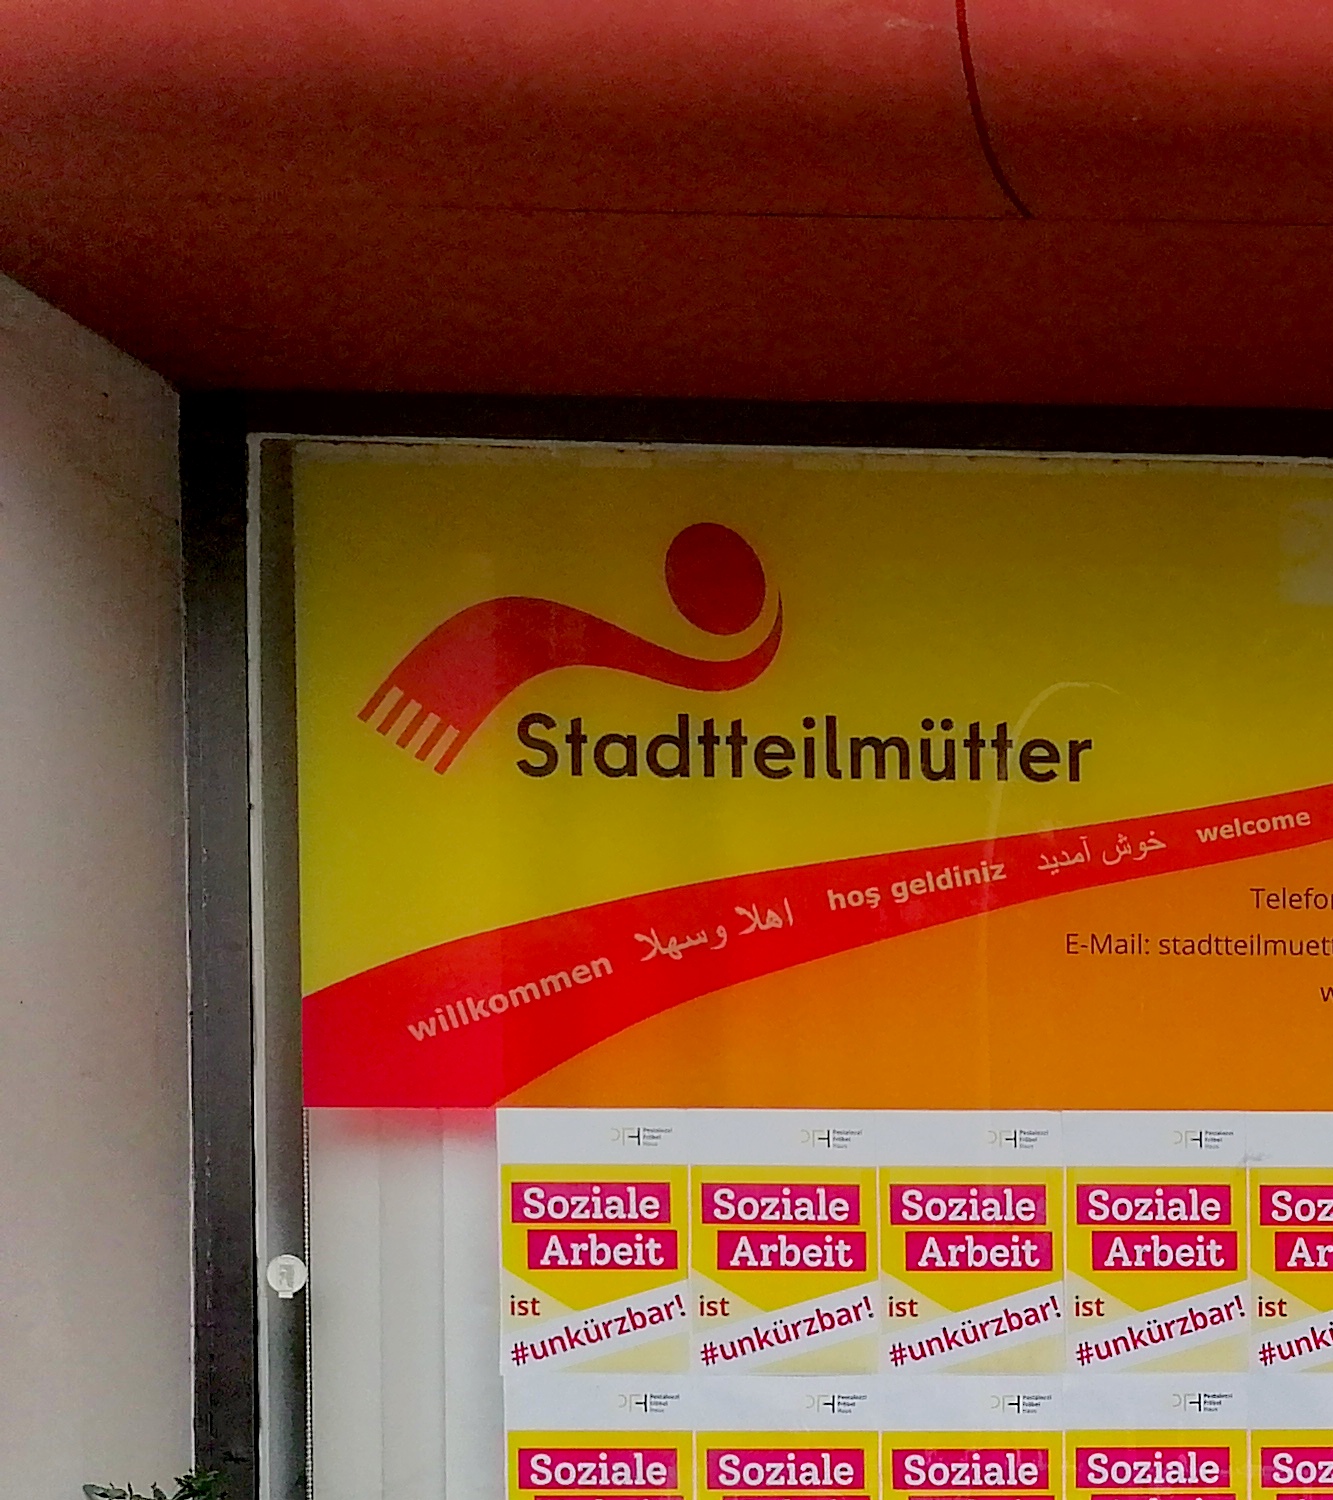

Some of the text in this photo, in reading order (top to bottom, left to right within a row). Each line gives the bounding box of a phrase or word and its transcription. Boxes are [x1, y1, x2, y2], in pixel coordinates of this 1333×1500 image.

[516, 712, 1093, 782] Stadtteilmütter
[1196, 809, 1311, 844] welcome
[1101, 827, 1167, 867] خوش
[827, 860, 1007, 911] hoş geldiniz
[1065, 932, 1150, 957] E-Mail:
[408, 955, 614, 1042] willkommen
[523, 1186, 660, 1220] Soziale
[713, 1187, 850, 1222] Soziale
[901, 1188, 1036, 1222] Soziale
[1088, 1188, 1221, 1221] Soziale
[540, 1233, 665, 1266] Arbeit
[729, 1234, 853, 1268] Arbeit
[917, 1235, 1040, 1268] Arbeit
[1104, 1234, 1225, 1267] Arbeit
[510, 1294, 541, 1317] ist
[699, 1294, 730, 1317] ist
[888, 1295, 919, 1318] ist
[1074, 1295, 1105, 1317] ist
[1257, 1295, 1288, 1318] ist
[510, 1294, 686, 1367] #unkürzbar!
[700, 1295, 874, 1367] #unkürzbar!
[888, 1295, 1062, 1368] #unkürzbar!
[1075, 1294, 1246, 1367] #unkürzbar!
[530, 1452, 667, 1486] Soziale
[718, 1452, 854, 1486] Soziale
[904, 1452, 1039, 1486] Soziale
[1087, 1451, 1220, 1485] Soziale
